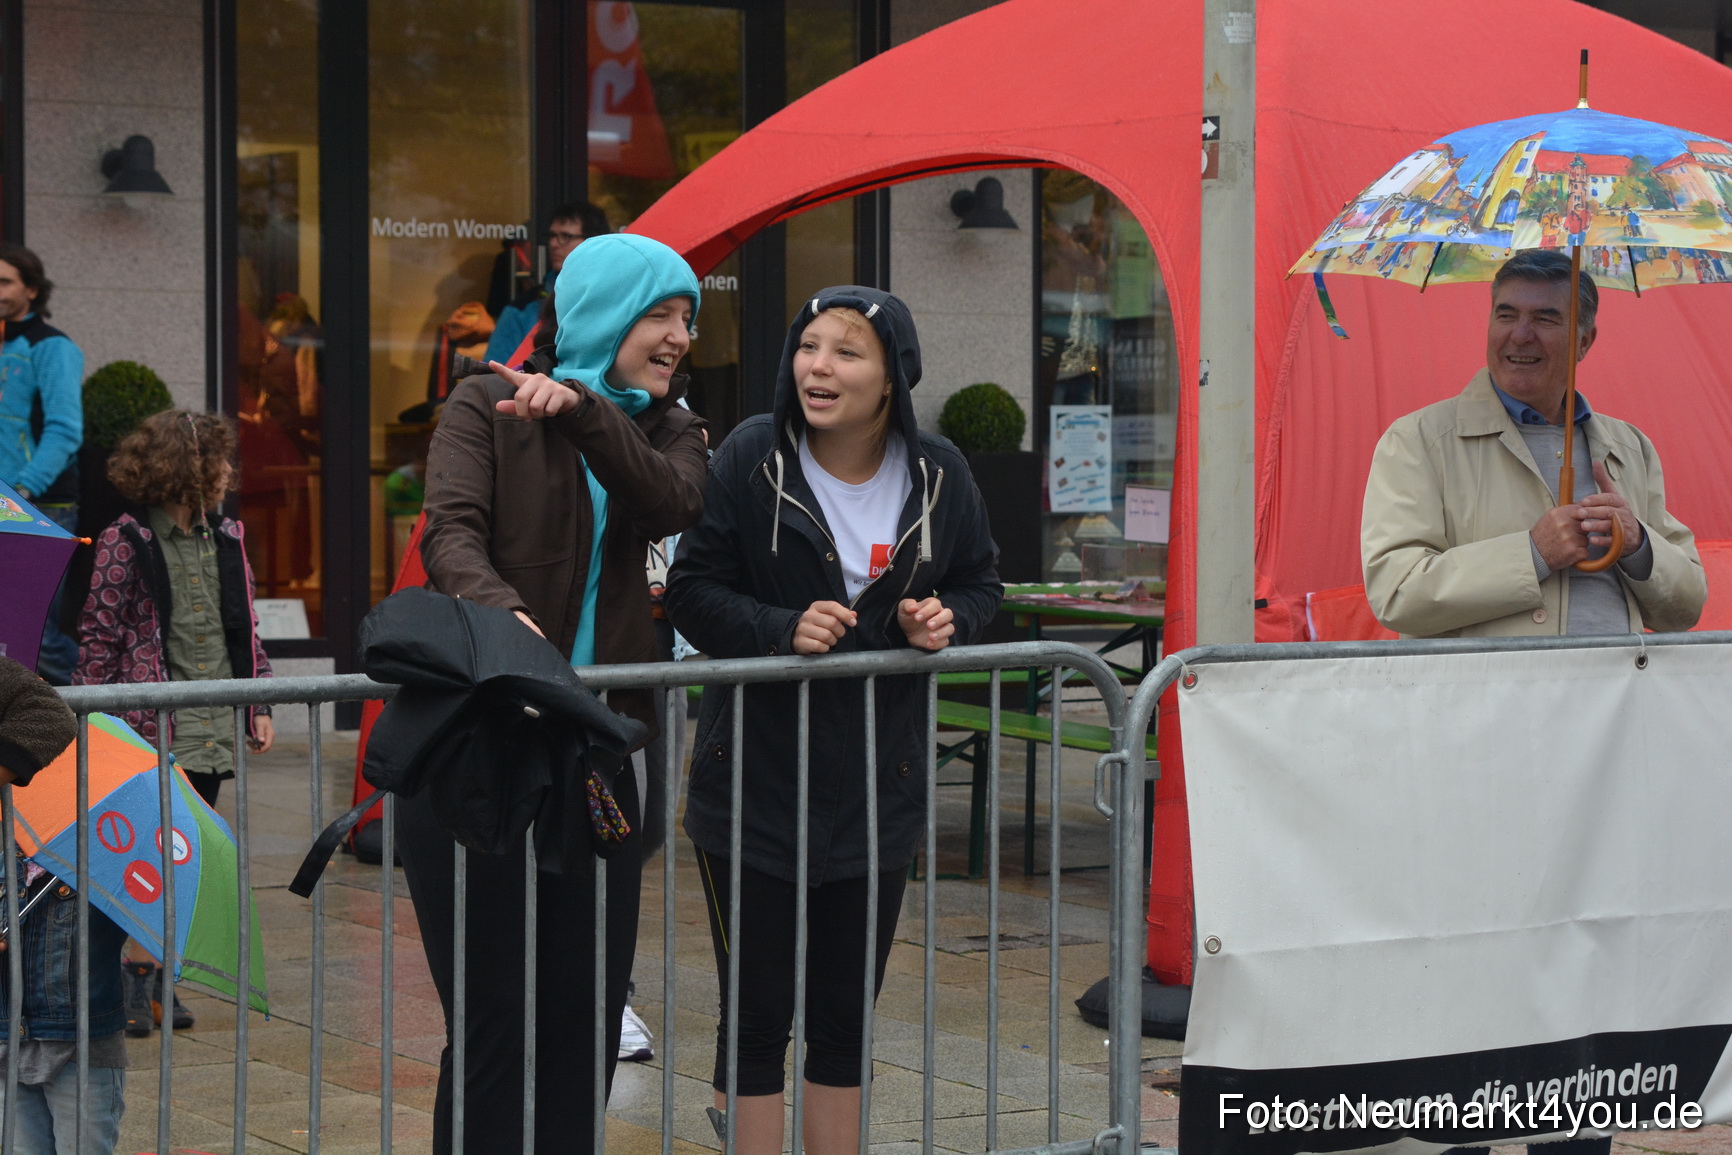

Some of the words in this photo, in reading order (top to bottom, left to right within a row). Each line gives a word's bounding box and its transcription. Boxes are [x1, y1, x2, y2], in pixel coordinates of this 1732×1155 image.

[372, 217, 449, 238] Modern
[453, 218, 528, 240] Women
[1471, 1079, 1517, 1115] die
[1526, 1062, 1677, 1106] verbinden
